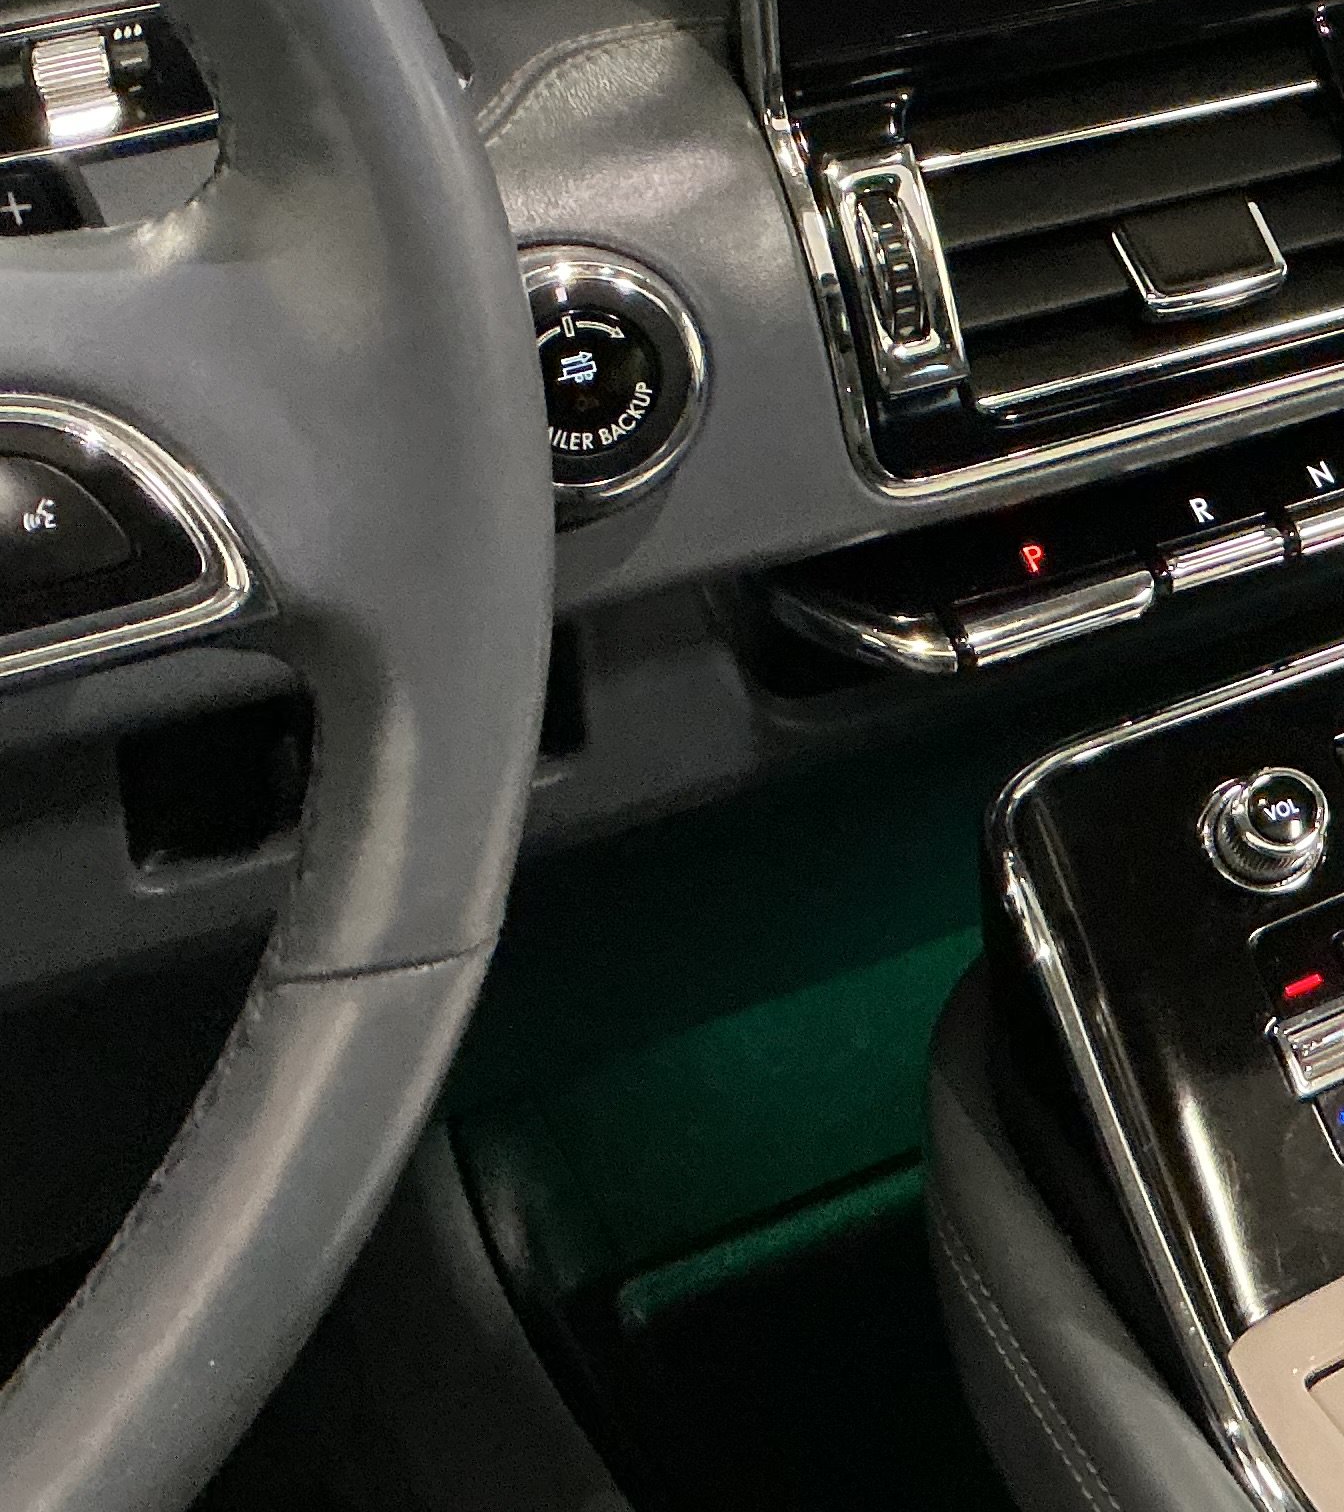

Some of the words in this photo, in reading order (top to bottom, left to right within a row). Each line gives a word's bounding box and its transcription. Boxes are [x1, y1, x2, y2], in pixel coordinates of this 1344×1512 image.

[597, 381, 653, 446] BACKUP
[1306, 460, 1336, 488] N
[1188, 497, 1215, 523] R
[1021, 544, 1045, 575] P
[1263, 797, 1301, 823] VOL
